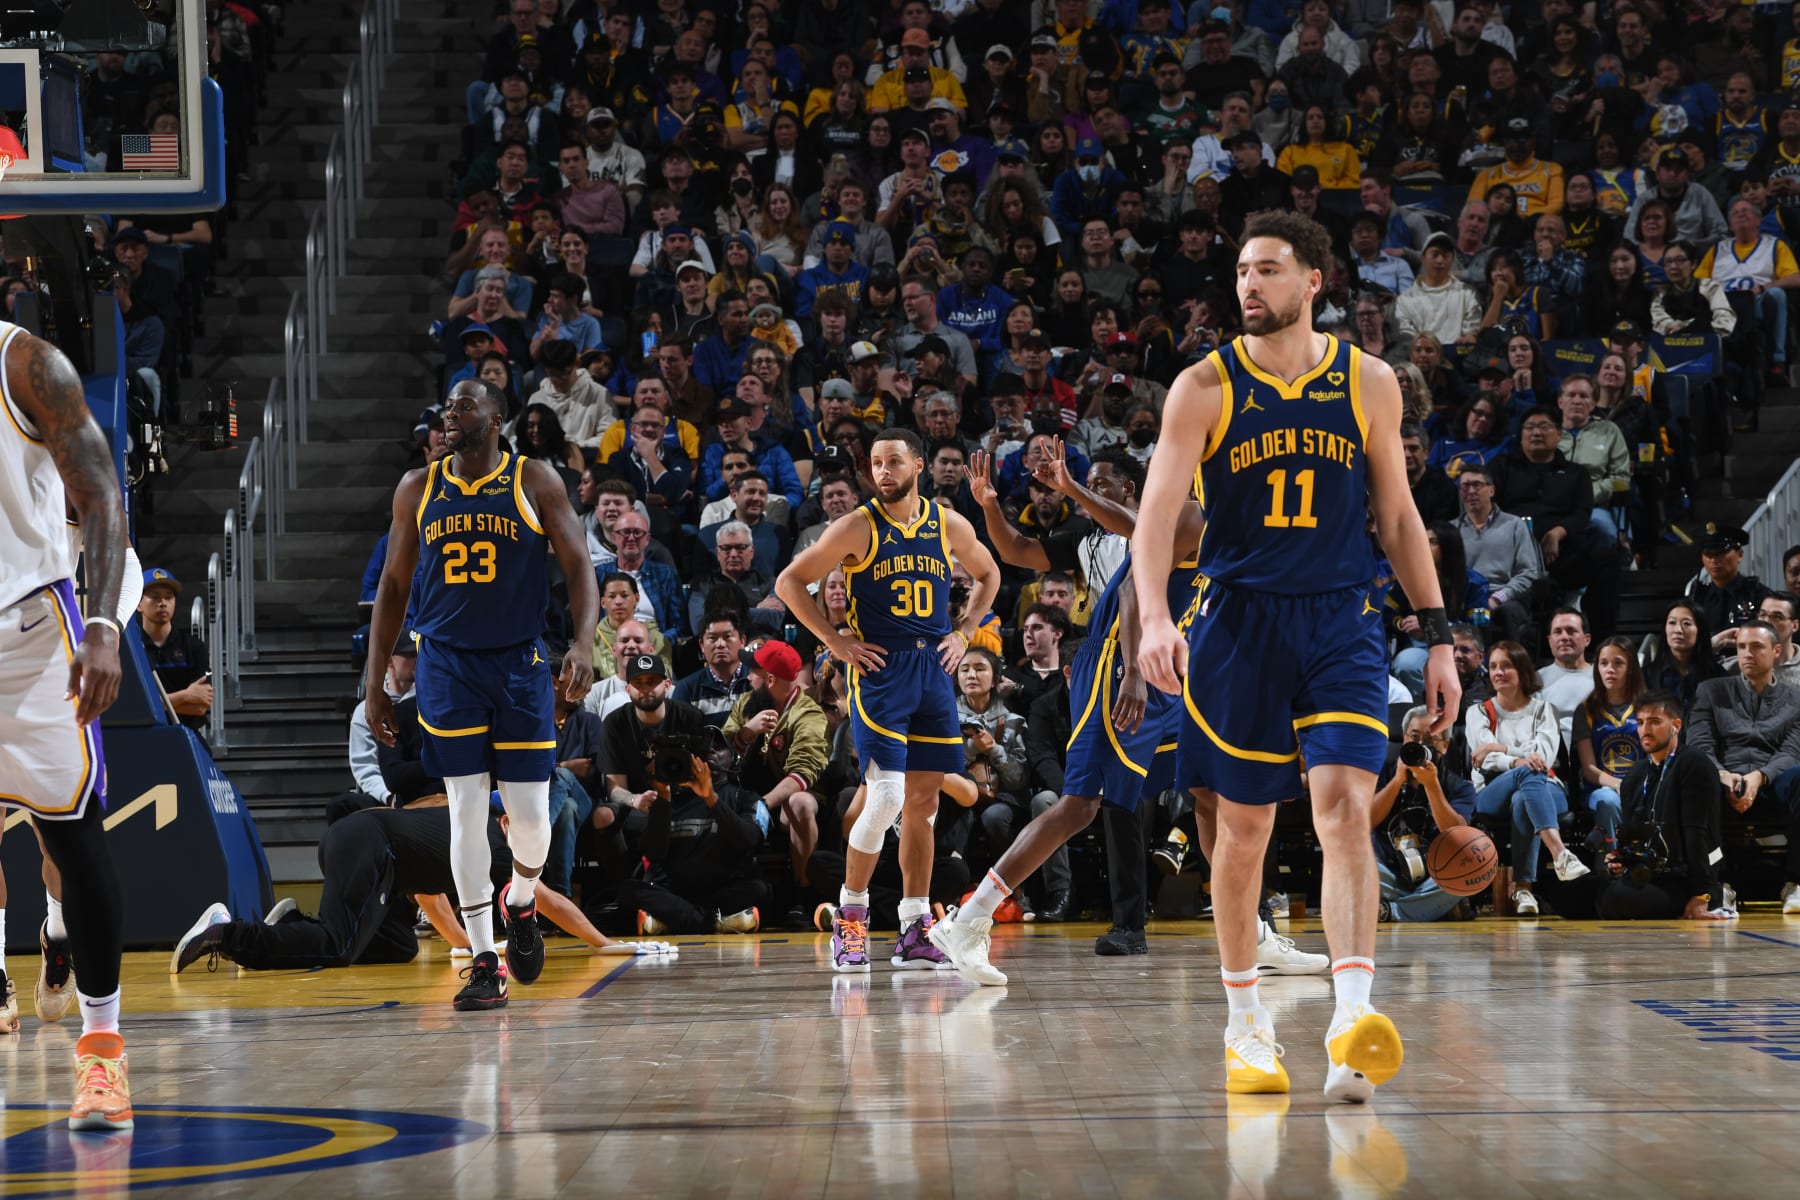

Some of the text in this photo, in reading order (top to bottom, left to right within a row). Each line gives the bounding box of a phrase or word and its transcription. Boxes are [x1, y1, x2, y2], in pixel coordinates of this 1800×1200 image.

[948, 310, 996, 321] ARMANI
[1309, 391, 1345, 402] Rakuten
[1229, 428, 1356, 474] GOLDEN STATE
[483, 487, 509, 496] Rakuten
[1264, 469, 1318, 528] 11
[425, 513, 519, 545] GOLDEN STATE
[442, 541, 497, 584] 23
[873, 555, 946, 582] GOLDEN STATE
[890, 579, 933, 617] 30
[1618, 744, 1632, 756] 30
